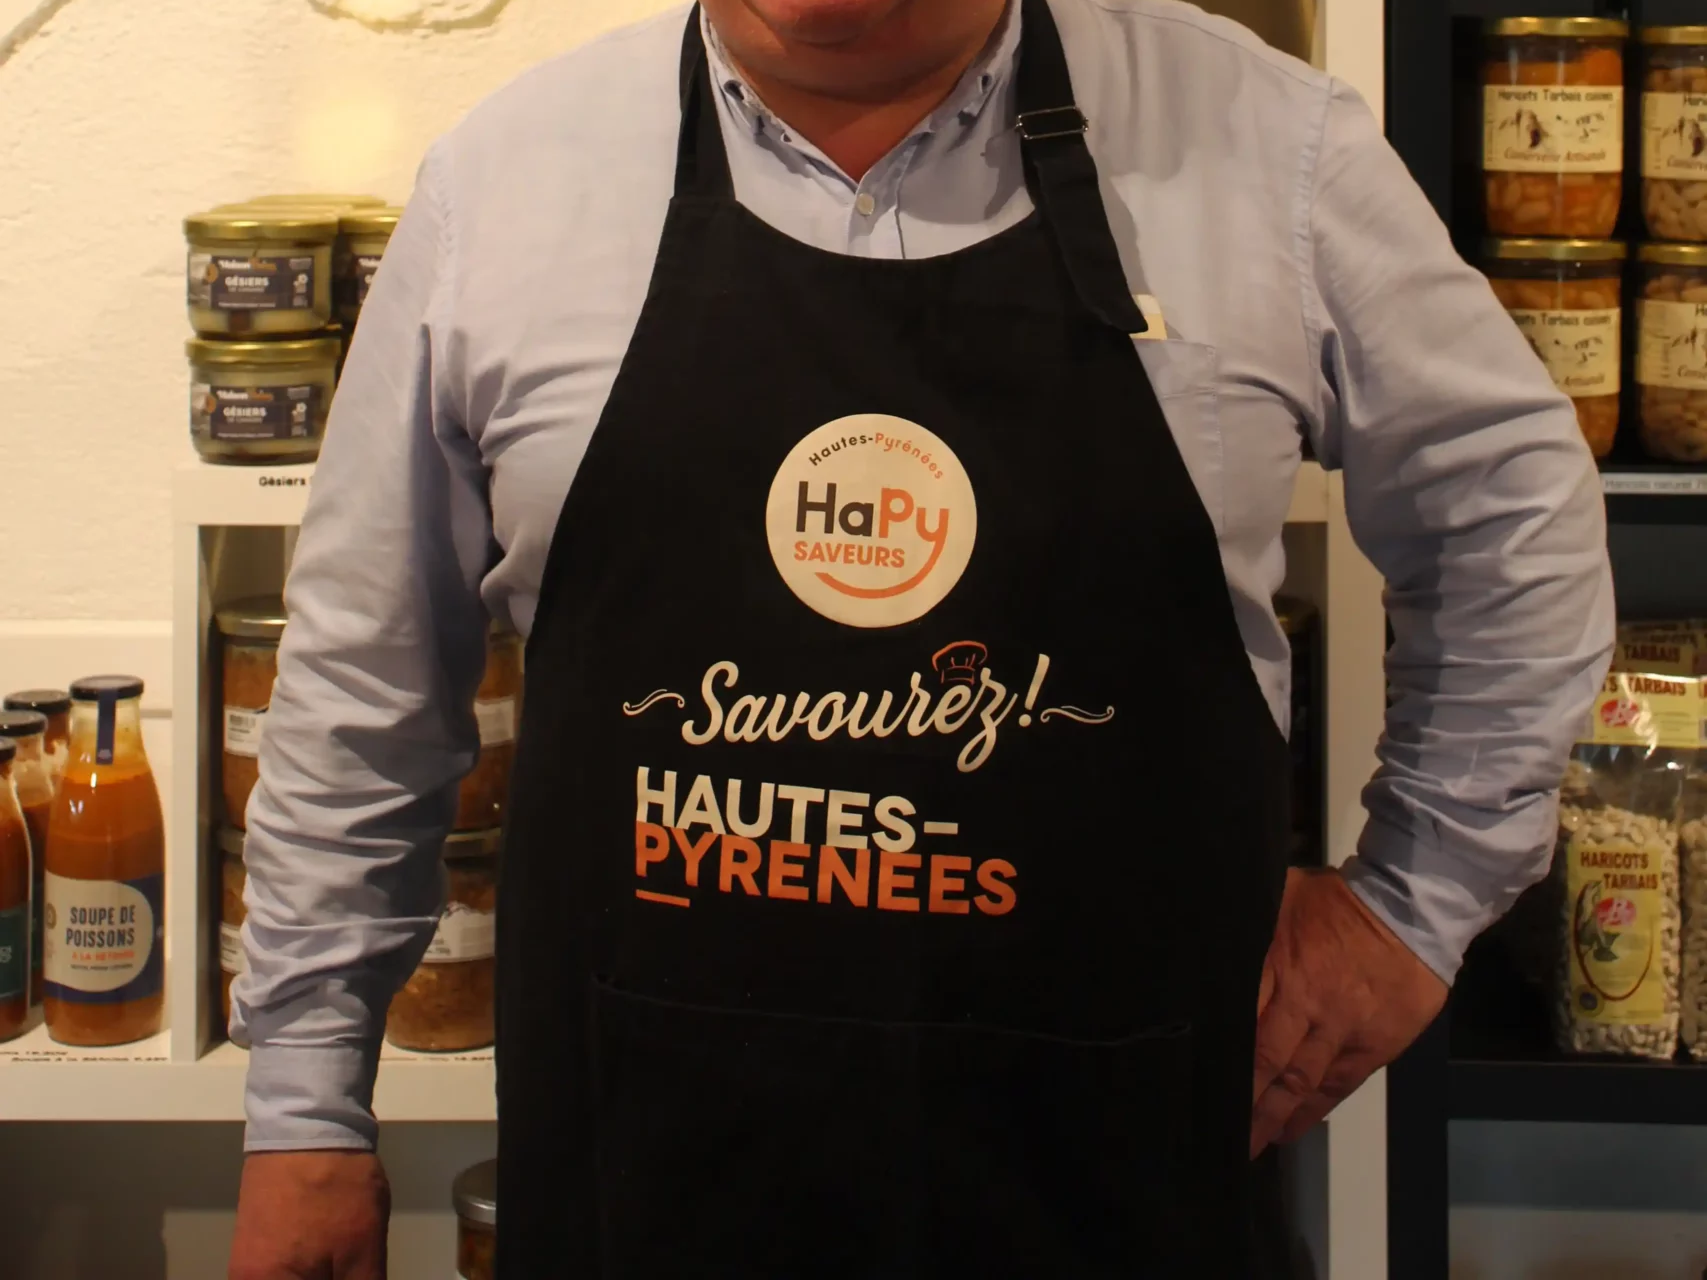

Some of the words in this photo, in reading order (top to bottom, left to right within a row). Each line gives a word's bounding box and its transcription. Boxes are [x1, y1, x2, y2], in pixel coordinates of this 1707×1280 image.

[809, 432, 944, 480] Hautes-Pyrénées
[794, 540, 905, 569] SAVEURS
[636, 766, 959, 853] HAUTES-
[635, 820, 1018, 916] PYRENEES
[1580, 851, 1649, 869] HARICOTS
[1603, 873, 1658, 890] TARBAIS
[70, 906, 115, 926] SOUPE
[119, 904, 136, 924] DE
[66, 927, 134, 948] POISSONS
